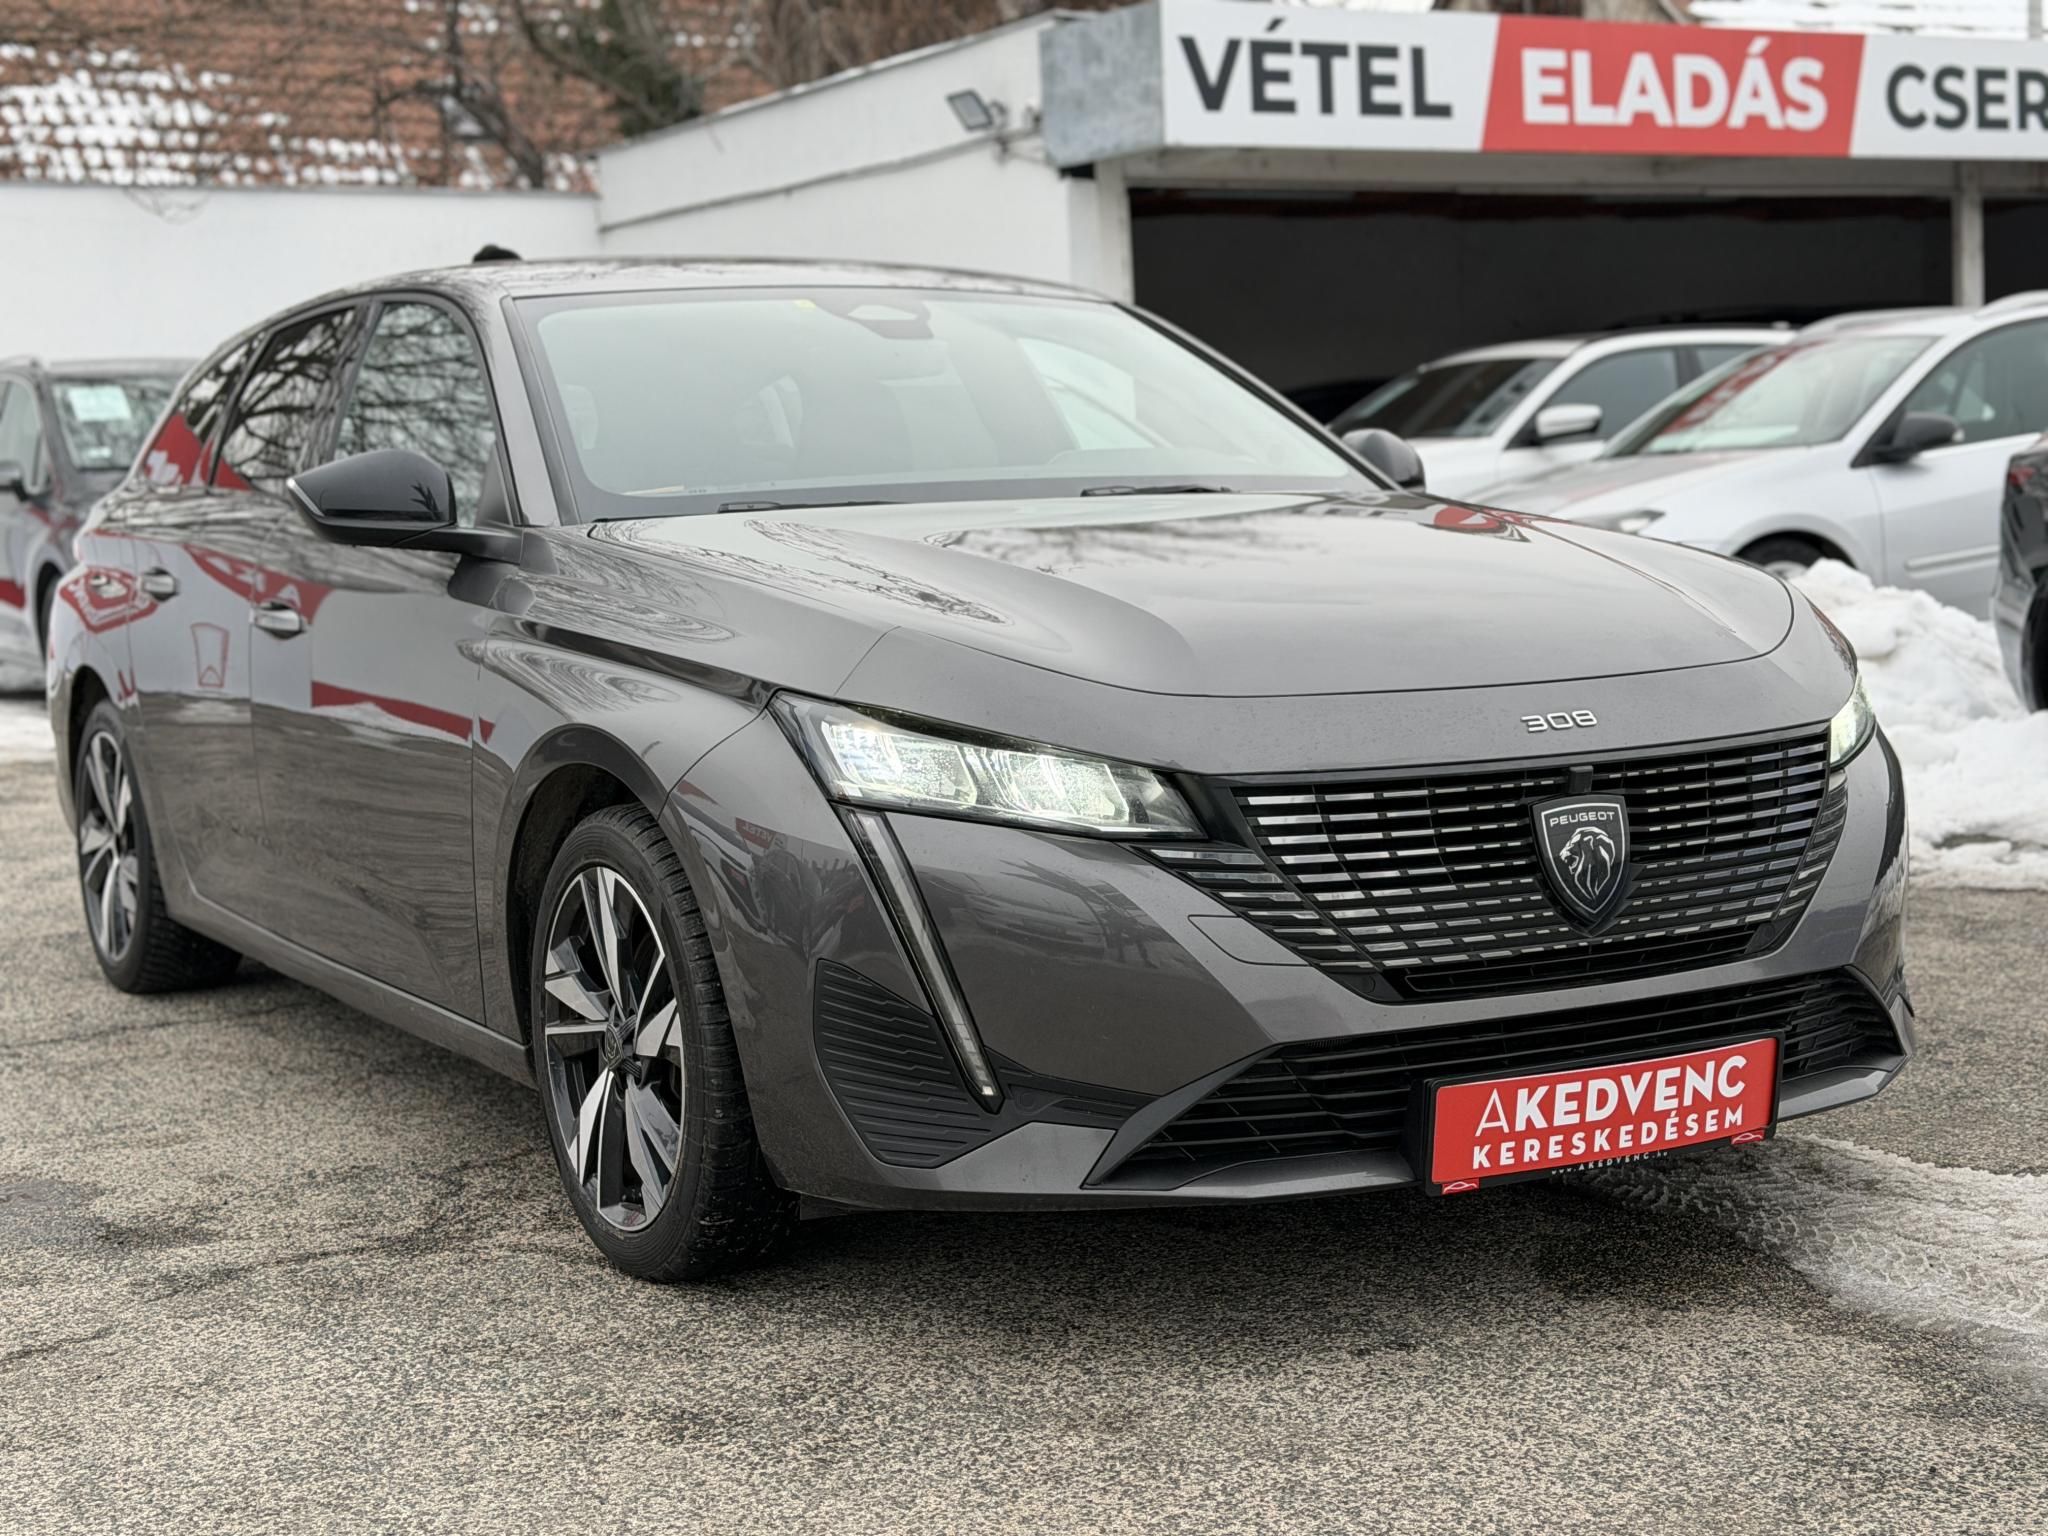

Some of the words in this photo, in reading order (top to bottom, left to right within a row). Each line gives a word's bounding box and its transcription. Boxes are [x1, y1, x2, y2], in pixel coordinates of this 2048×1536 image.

[1179, 18, 1452, 118] VÉTEL
[1521, 39, 1828, 131] ELADÁS
[1521, 709, 1599, 733] 308
[1548, 810, 1616, 828] PEUGEOT
[1472, 1103, 1744, 1171] KERESKEDÉSEM
